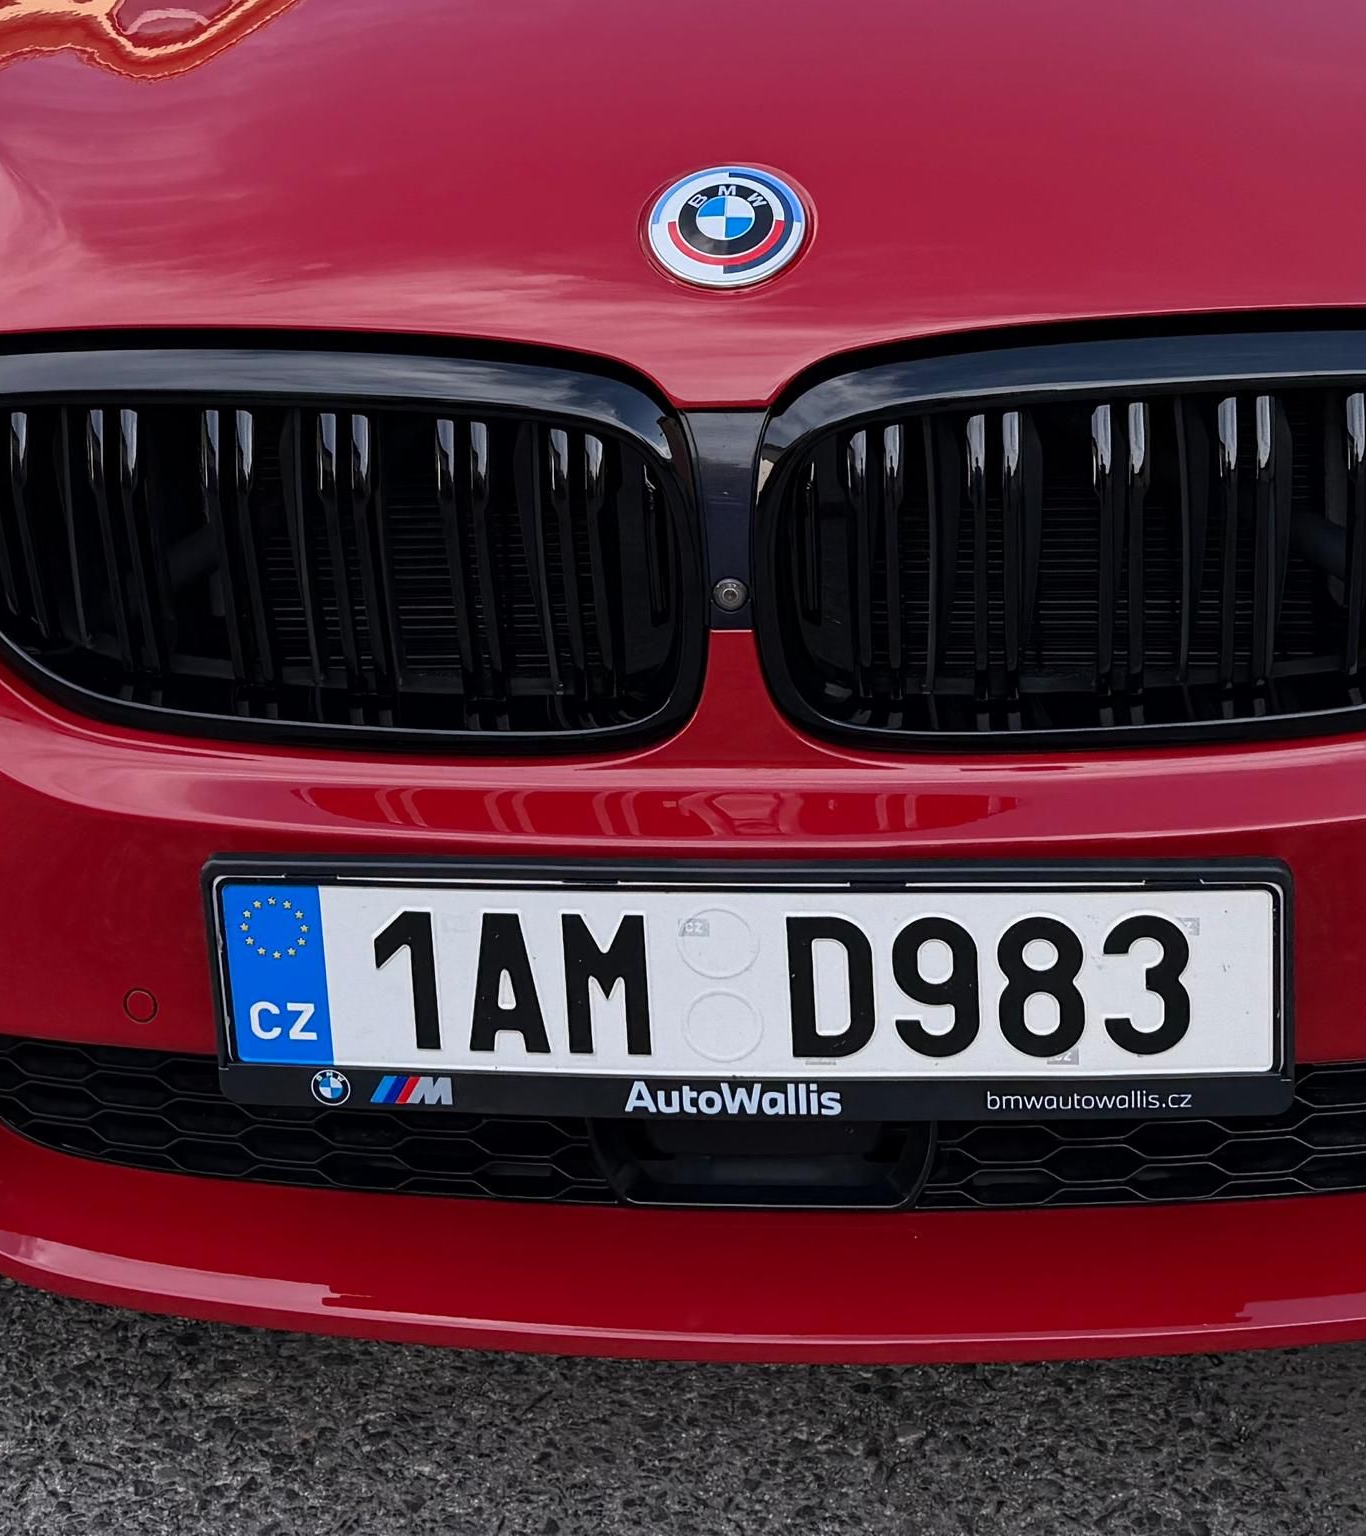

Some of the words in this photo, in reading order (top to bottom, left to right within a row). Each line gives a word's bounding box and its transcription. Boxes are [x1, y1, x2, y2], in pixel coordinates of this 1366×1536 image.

[687, 185, 768, 209] BMW
[374, 910, 652, 1056] 1AM
[786, 914, 1191, 1058] D983
[249, 1000, 318, 1041] CZ
[315, 1071, 345, 1082] BMW
[406, 1075, 454, 1105] M
[624, 1080, 843, 1115] AutoWallis
[986, 1090, 1192, 1110] bmwautowallis.cz
